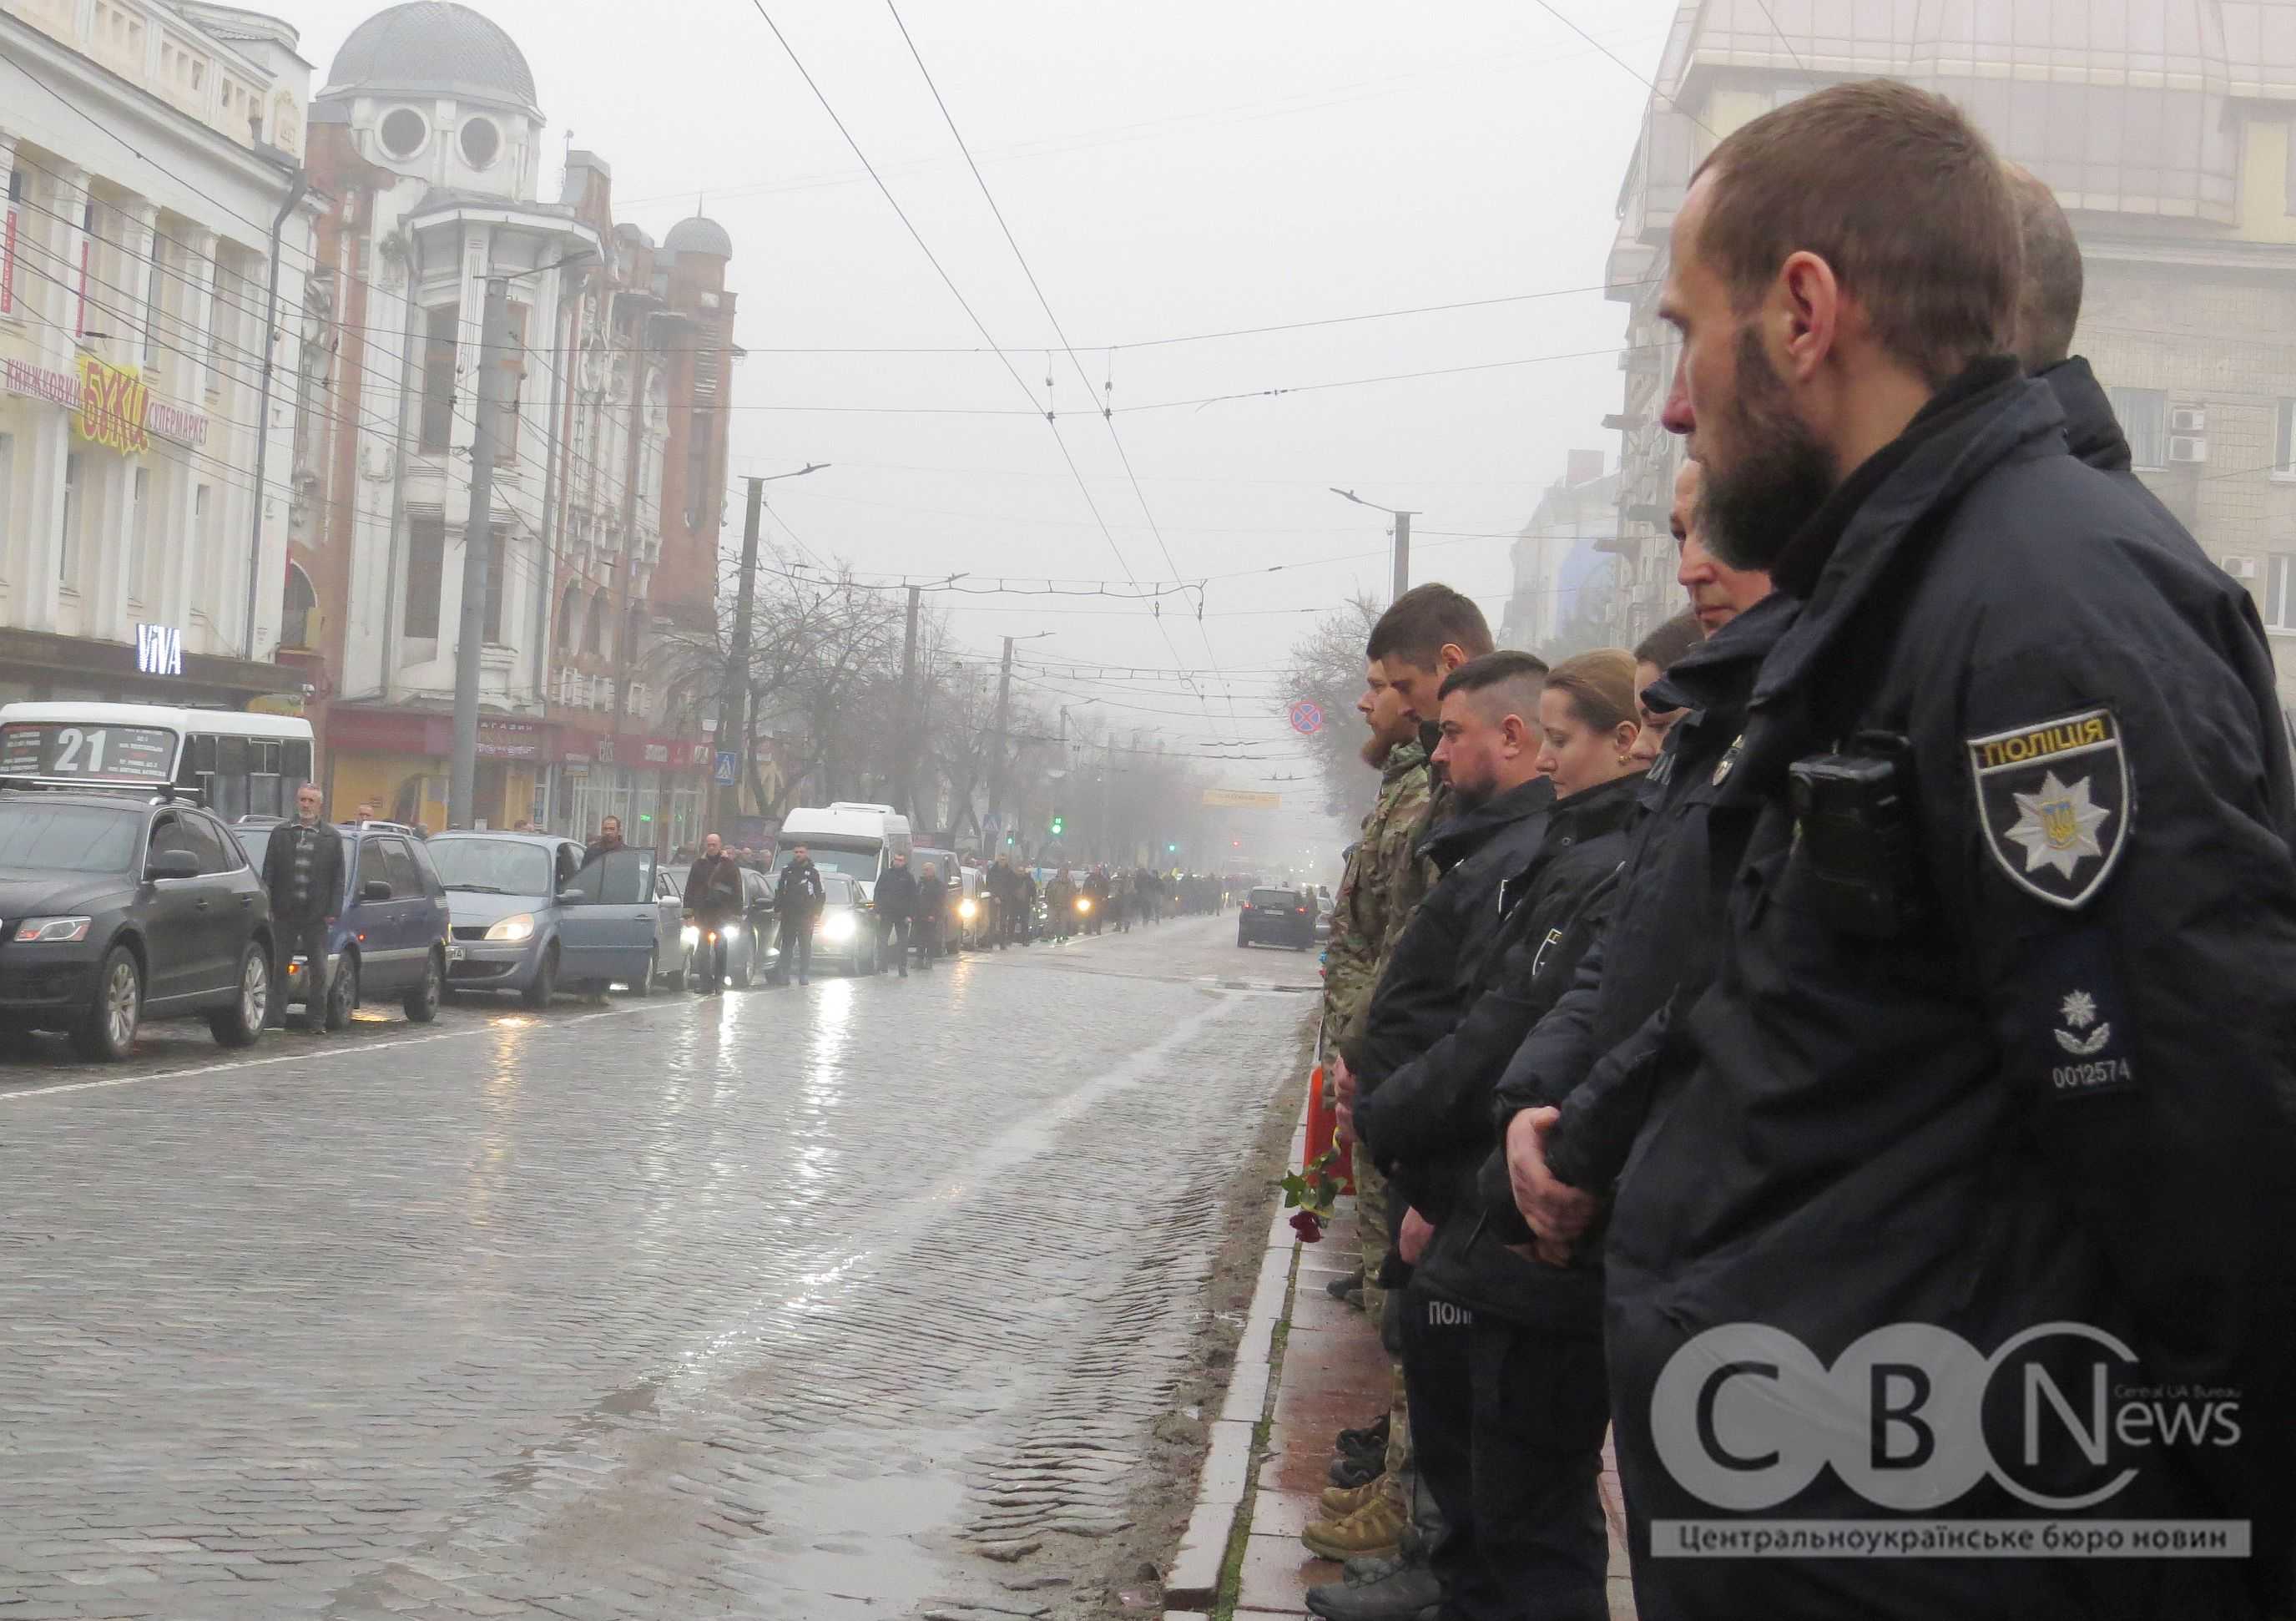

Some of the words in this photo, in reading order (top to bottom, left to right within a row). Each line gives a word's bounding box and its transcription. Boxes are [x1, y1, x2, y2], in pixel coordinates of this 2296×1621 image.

[54, 728, 107, 772] 21
[1985, 719, 2105, 766] ПОЛІЦІЯ
[2053, 1058, 2130, 1088] 0012574
